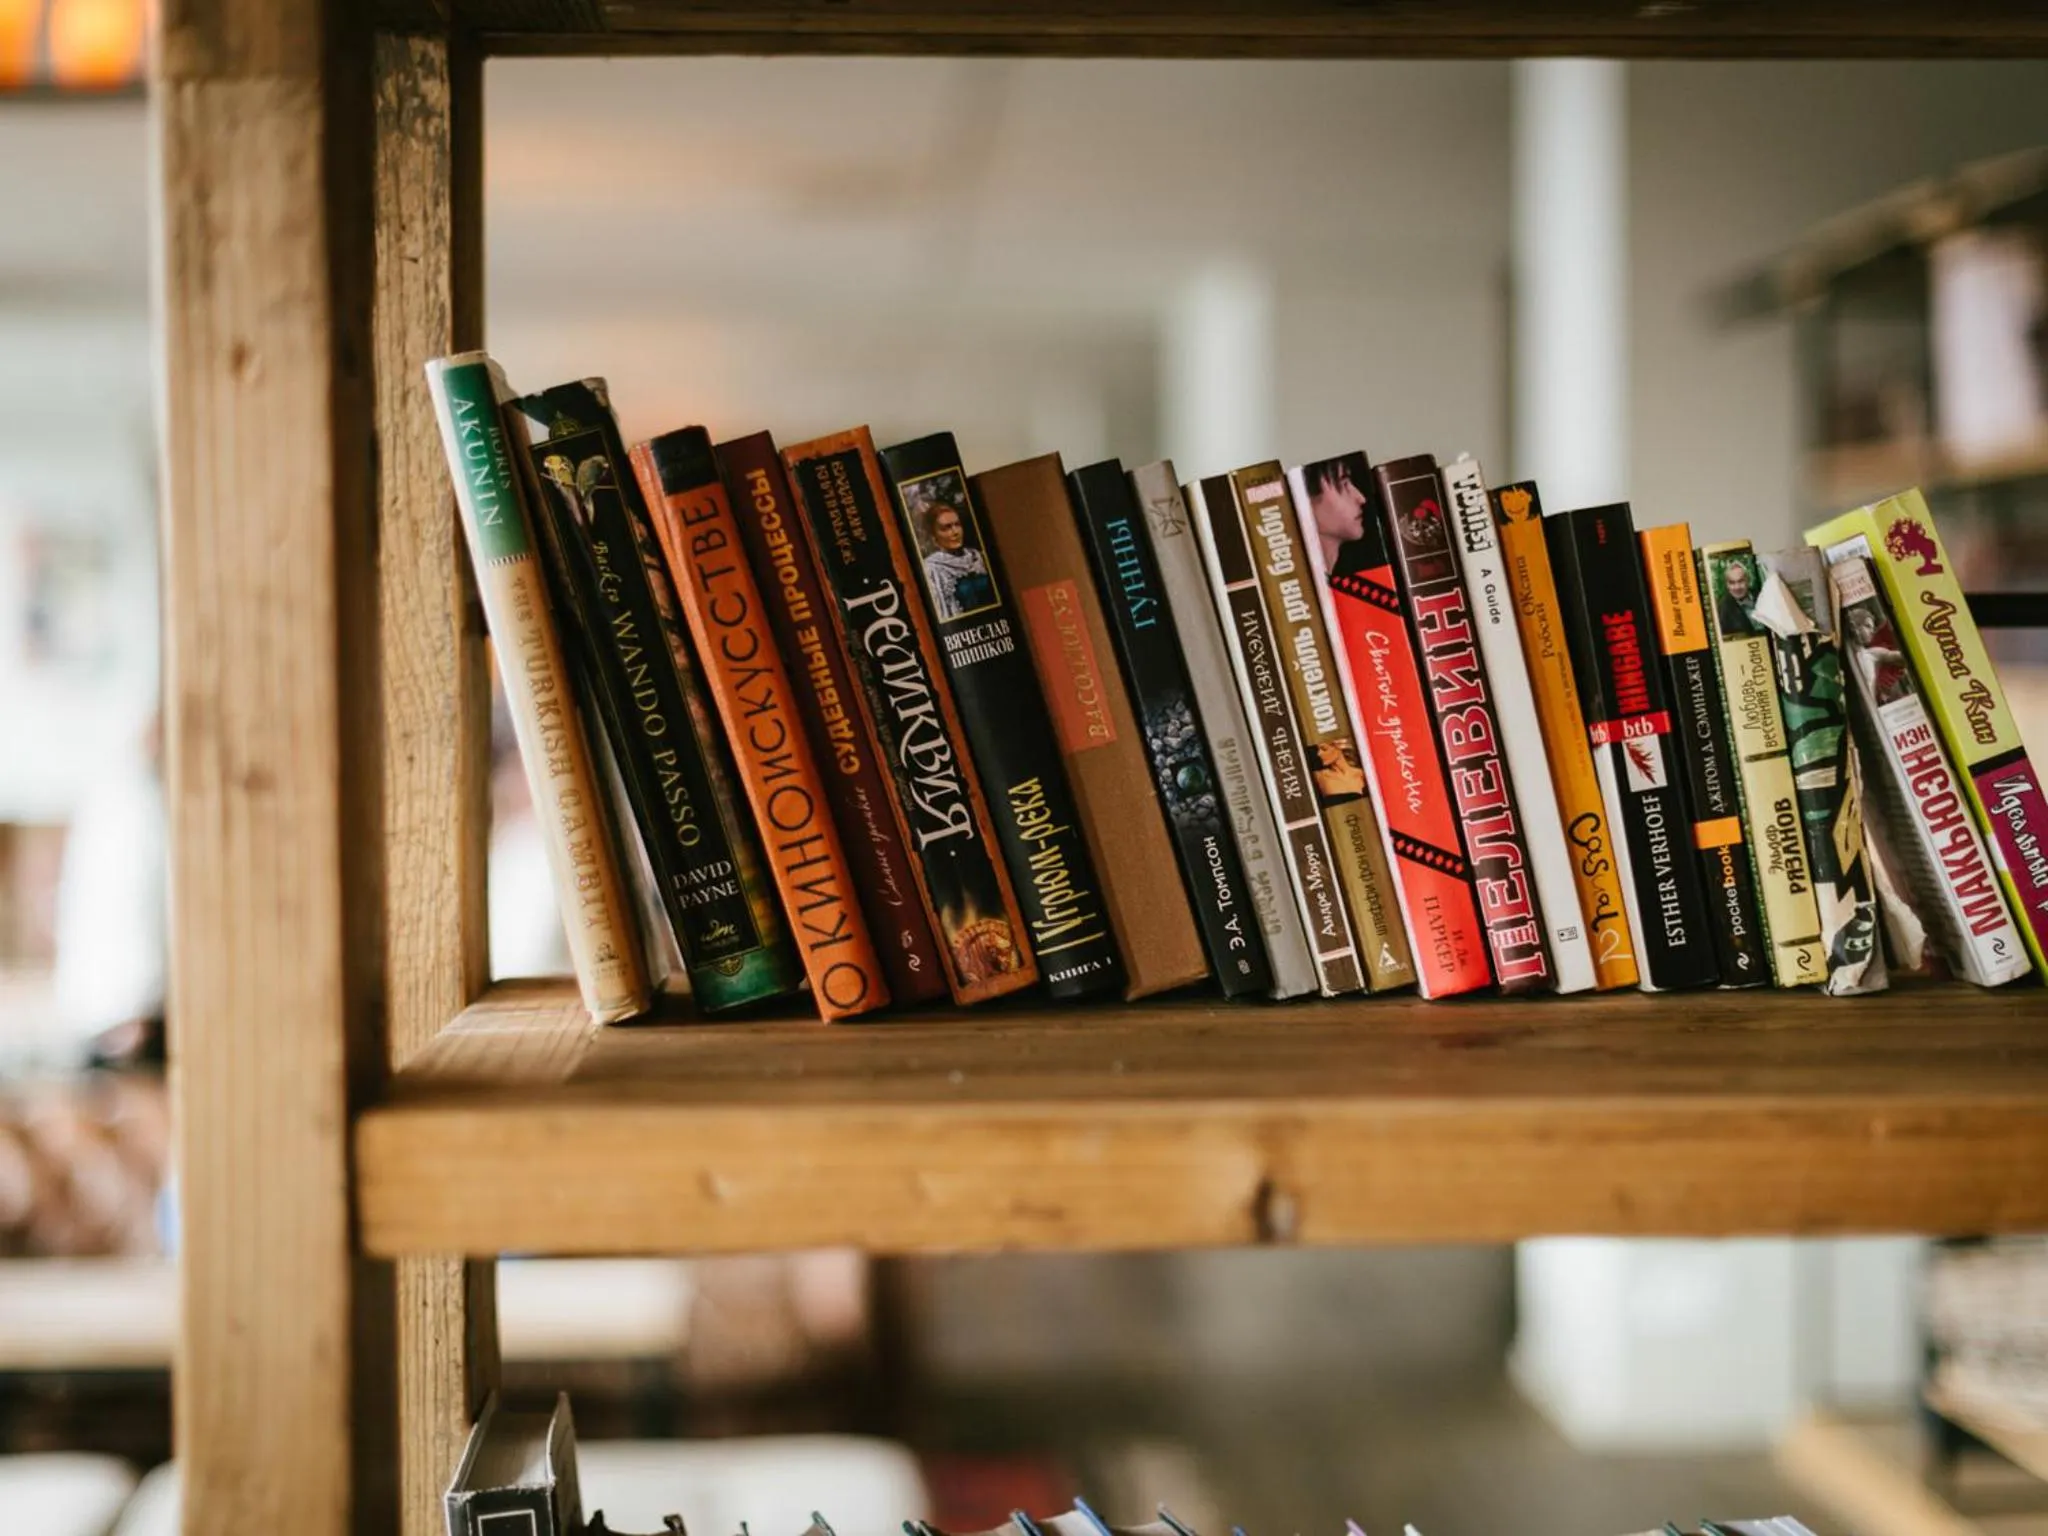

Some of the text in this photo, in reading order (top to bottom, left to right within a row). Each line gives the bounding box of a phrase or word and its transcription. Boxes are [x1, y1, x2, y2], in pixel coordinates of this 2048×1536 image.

[452, 397, 503, 527] AKUNIN
[751, 468, 815, 622] ПРОЦЕССЫ
[1106, 517, 1158, 630] ГУННЫ
[1256, 504, 1296, 576] барби
[1453, 473, 1501, 625] Tbilisi A Guide
[510, 576, 534, 622] THE
[944, 619, 1010, 652] ВЯЧЕСЛАВ
[1279, 578, 1313, 624] для
[950, 636, 1015, 669] ШИШКОВ
[1292, 626, 1338, 736] коктейль
[1365, 630, 1397, 713] Свиток
[1602, 609, 1649, 714] HINGABE
[1748, 639, 1778, 748] весенняя страна
[518, 627, 575, 780] TURKISH
[612, 611, 667, 737] WANDO
[653, 750, 700, 847] PASSO
[682, 497, 855, 954] КИНОИСКУССТВЕ
[798, 624, 861, 775] СУДЕБНЫЕ
[1240, 609, 1301, 800] ЖИЗНЬ ДИЗРАЭЛИ
[1622, 716, 1654, 738] btb
[1686, 656, 1711, 738] СЭЛИНДЖЕР
[1739, 680, 1762, 731] Любовь
[1893, 723, 1932, 751] ИЭН
[1959, 678, 1998, 744] Кин
[1411, 584, 1547, 985] ПЕЛЕВИН
[1704, 756, 1725, 813] ДЖЕРОМ
[558, 788, 613, 934] GAMBIT
[673, 860, 732, 889] DAVID
[1642, 795, 1686, 947] ESTHER VERHOEF
[1765, 823, 1786, 875] Эльдар
[1774, 797, 1807, 895] РЯЗАНОВ
[1901, 743, 2008, 937] МАКЬЮЭН
[680, 880, 740, 909] PAYNE
[1225, 913, 1246, 951] Э.А.
[1304, 843, 1337, 937] Андре Моруа
[1568, 811, 1619, 934] Casual
[1600, 928, 1632, 965] 2
[1048, 962, 1101, 983] КНИГА
[1424, 895, 1455, 973] ПАРКЕР
[822, 962, 870, 1009] О
